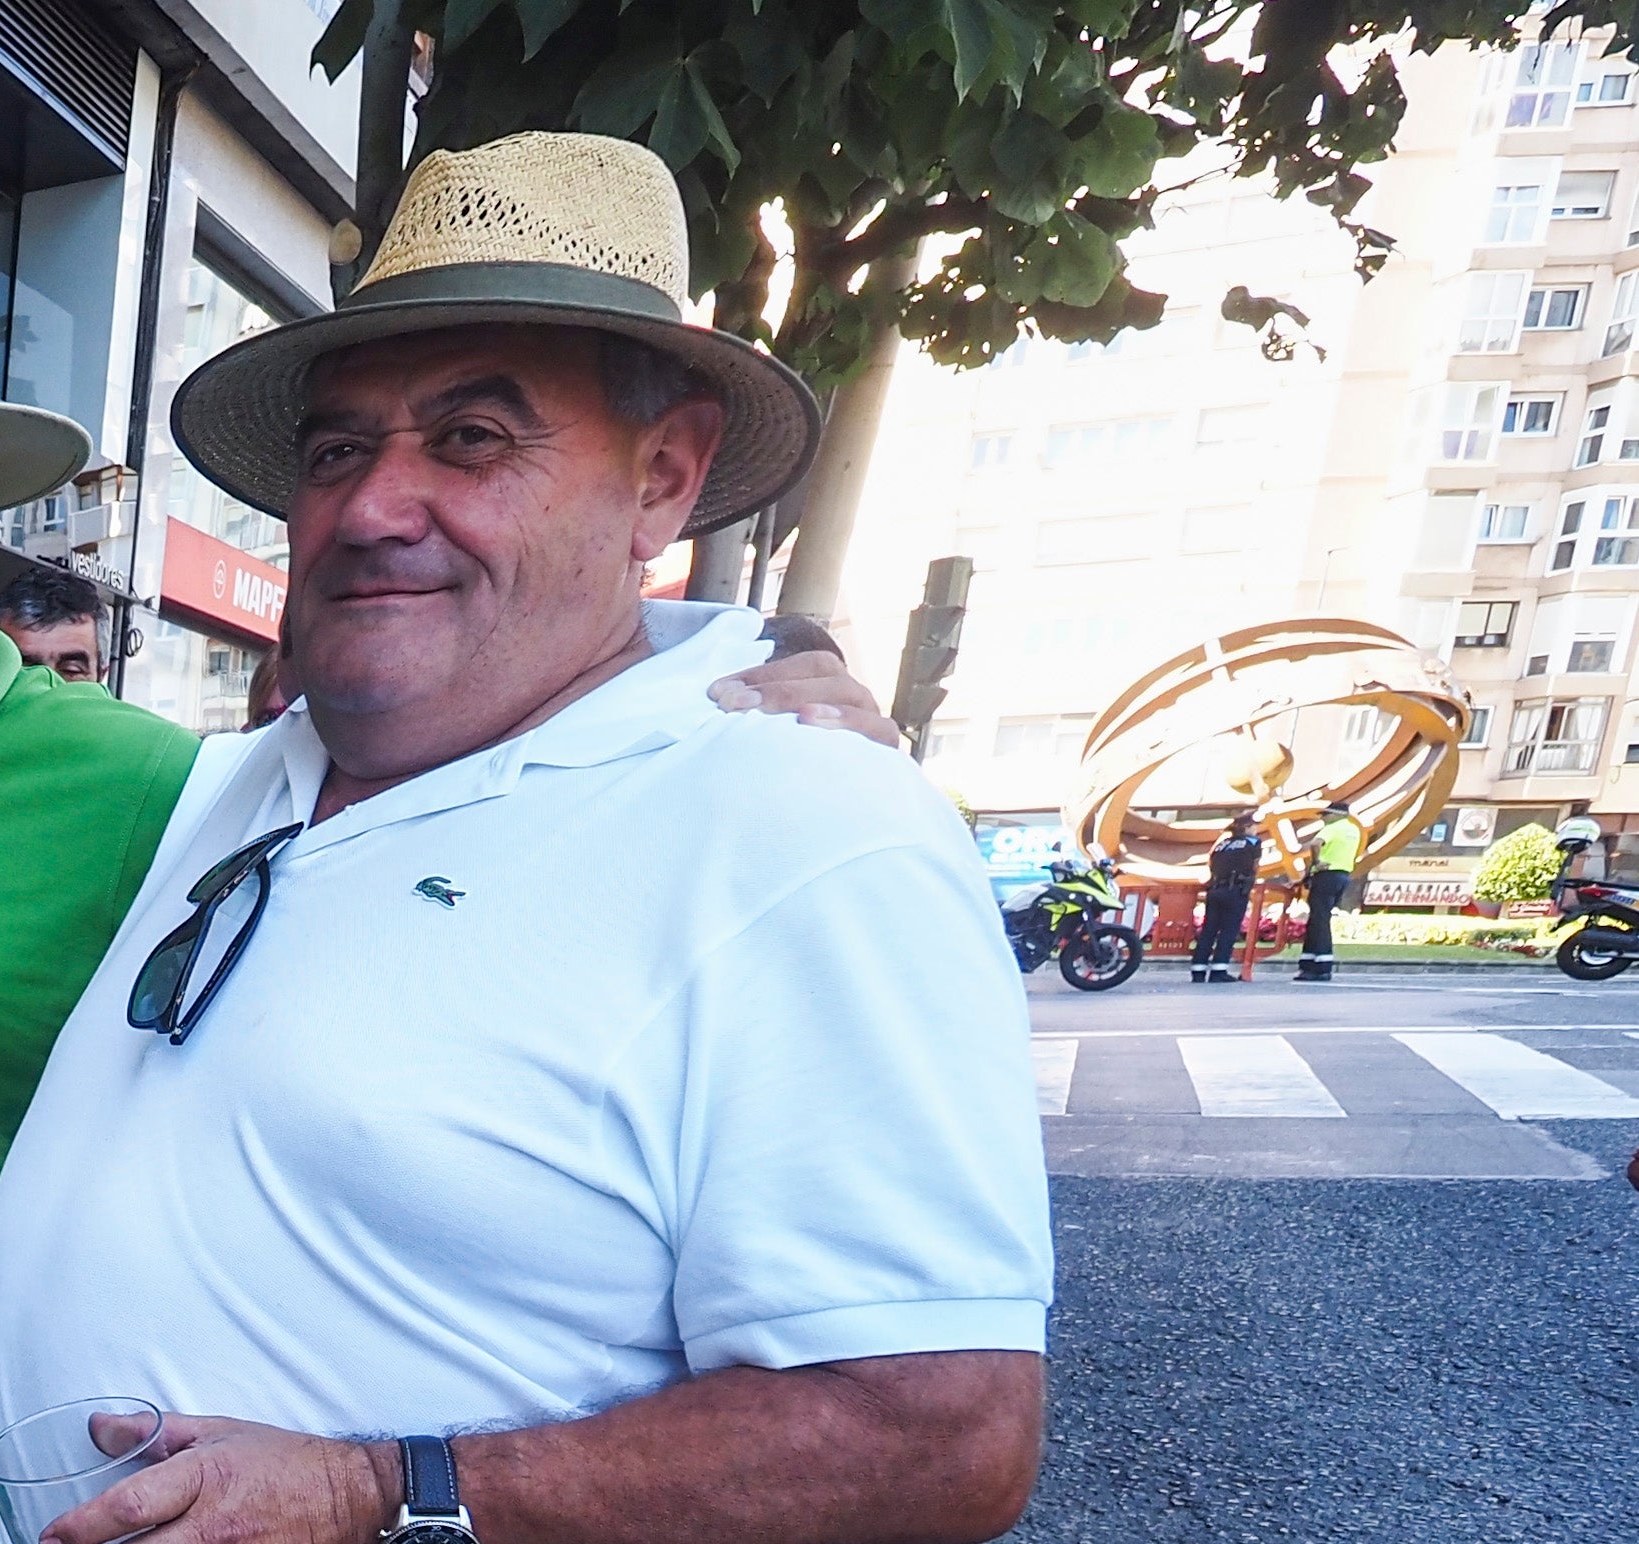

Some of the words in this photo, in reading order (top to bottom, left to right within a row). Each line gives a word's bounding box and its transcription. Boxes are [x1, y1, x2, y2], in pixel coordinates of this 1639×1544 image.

[72, 551, 125, 591] vestidores
[1368, 892, 1394, 903] SAN
[1396, 892, 1471, 904] FERNANDO
